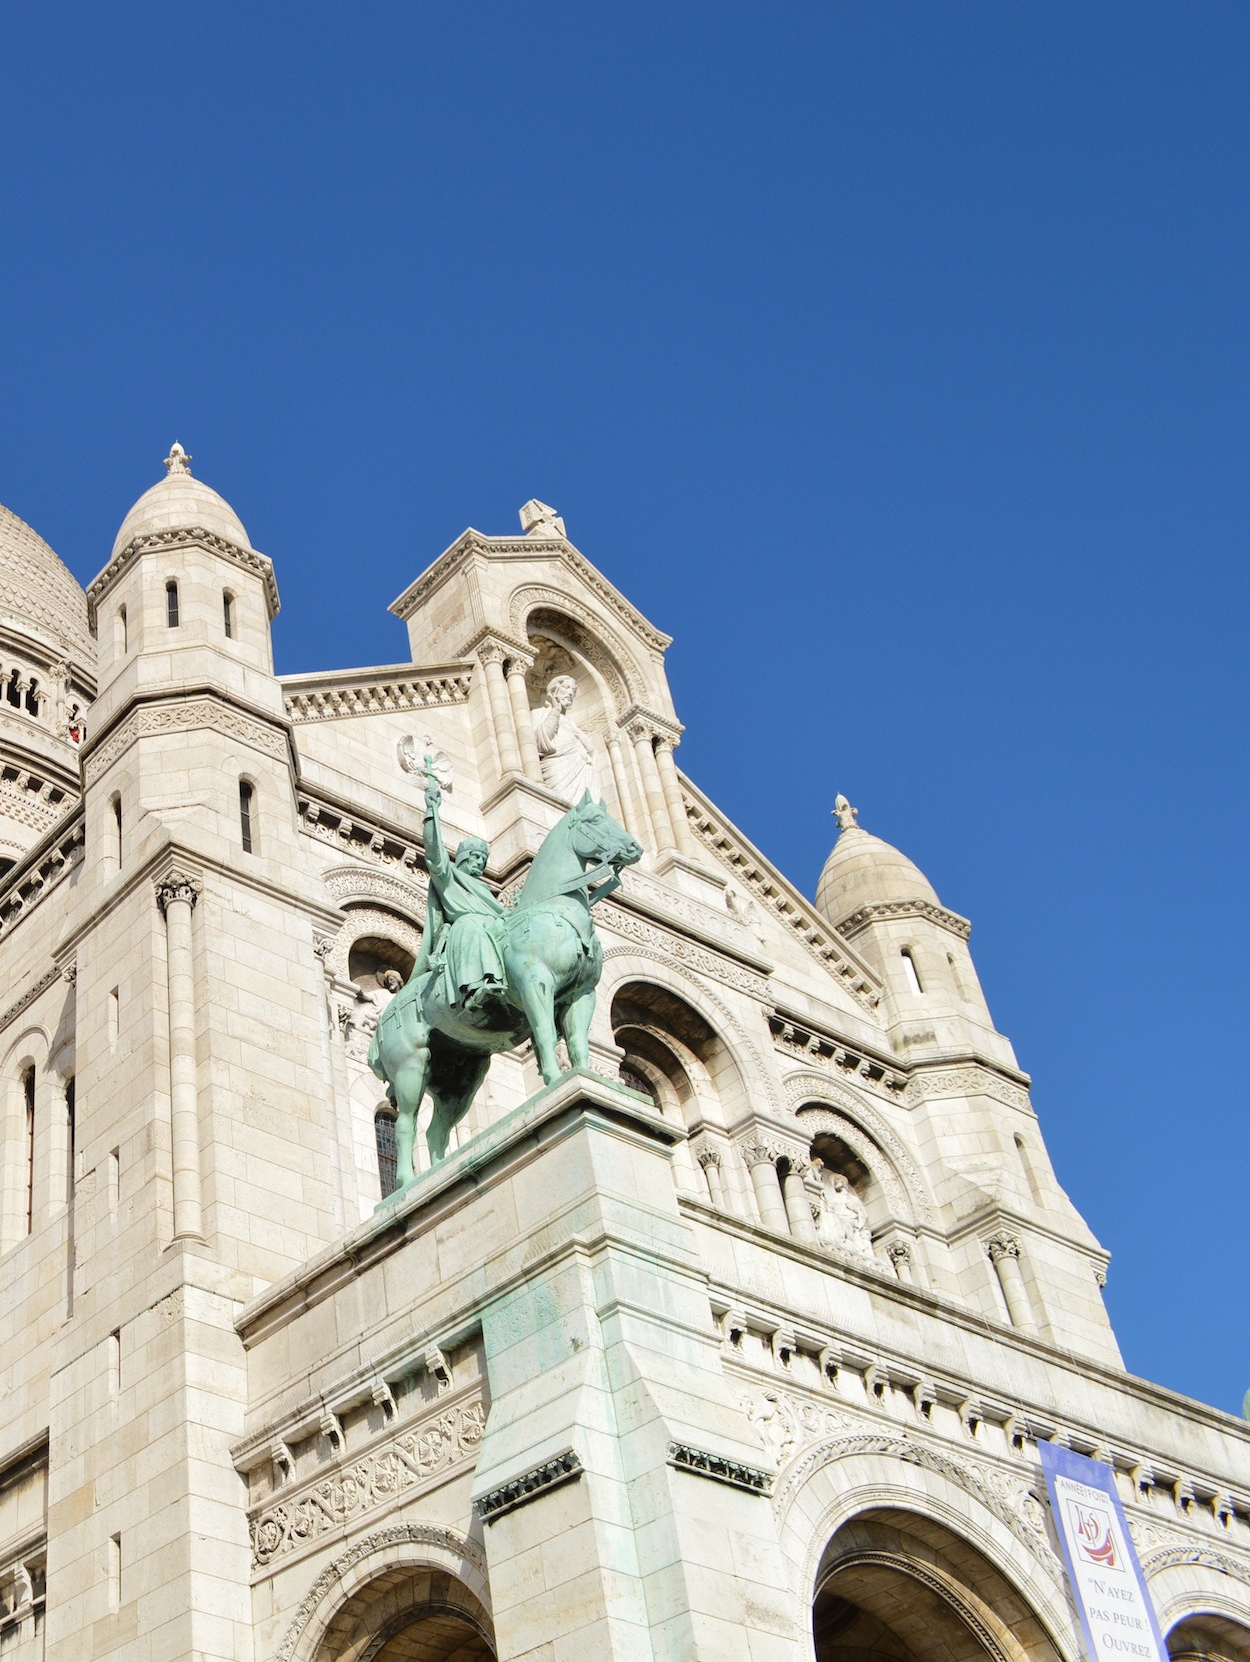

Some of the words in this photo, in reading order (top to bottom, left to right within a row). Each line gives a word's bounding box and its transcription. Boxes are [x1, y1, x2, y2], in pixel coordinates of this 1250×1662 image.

[1089, 1607, 1110, 1622] PAS
[1113, 1612, 1143, 1630] PEUR
[1102, 1633, 1152, 1658] OUVREZ
